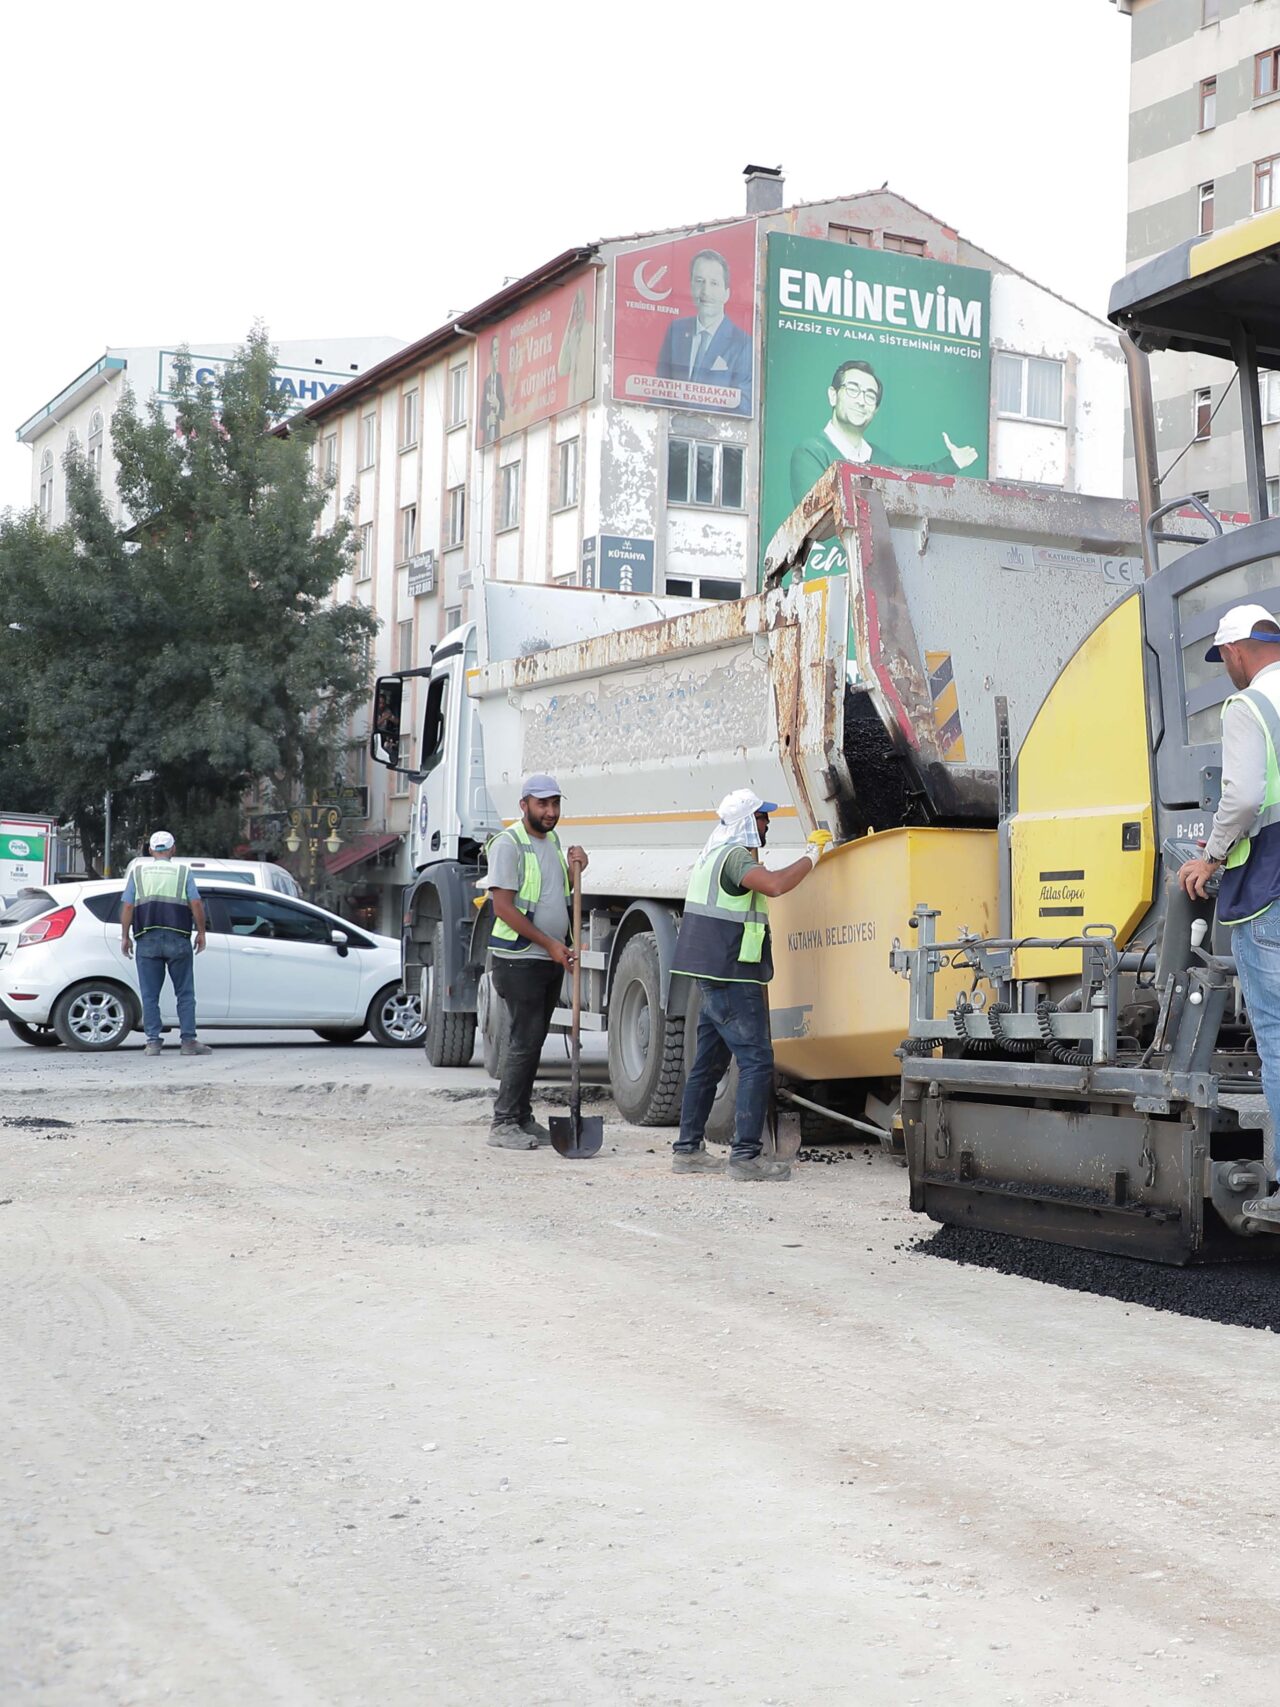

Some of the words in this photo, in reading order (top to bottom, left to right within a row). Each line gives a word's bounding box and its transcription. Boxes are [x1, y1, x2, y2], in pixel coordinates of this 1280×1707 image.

[625, 301, 655, 311] YENİDEN
[779, 268, 982, 338] EMİNEVİM
[778, 319, 822, 334] FAİZSİZ
[826, 326, 840, 336] EV
[844, 329, 875, 342] ALMA
[879, 334, 940, 352] SİSTEMİNİN
[944, 345, 981, 359] MUCİDİ
[643, 387, 679, 399] GENEL
[685, 384, 737, 398] ERBAKAN
[608, 549, 646, 561] KÜTAHYA
[1176, 822, 1204, 839] B-483
[1039, 885, 1061, 901] Atlas
[1062, 885, 1085, 903] Copco
[787, 930, 823, 952] KÜTAHYA
[825, 921, 876, 947] BELEDİYESİ
